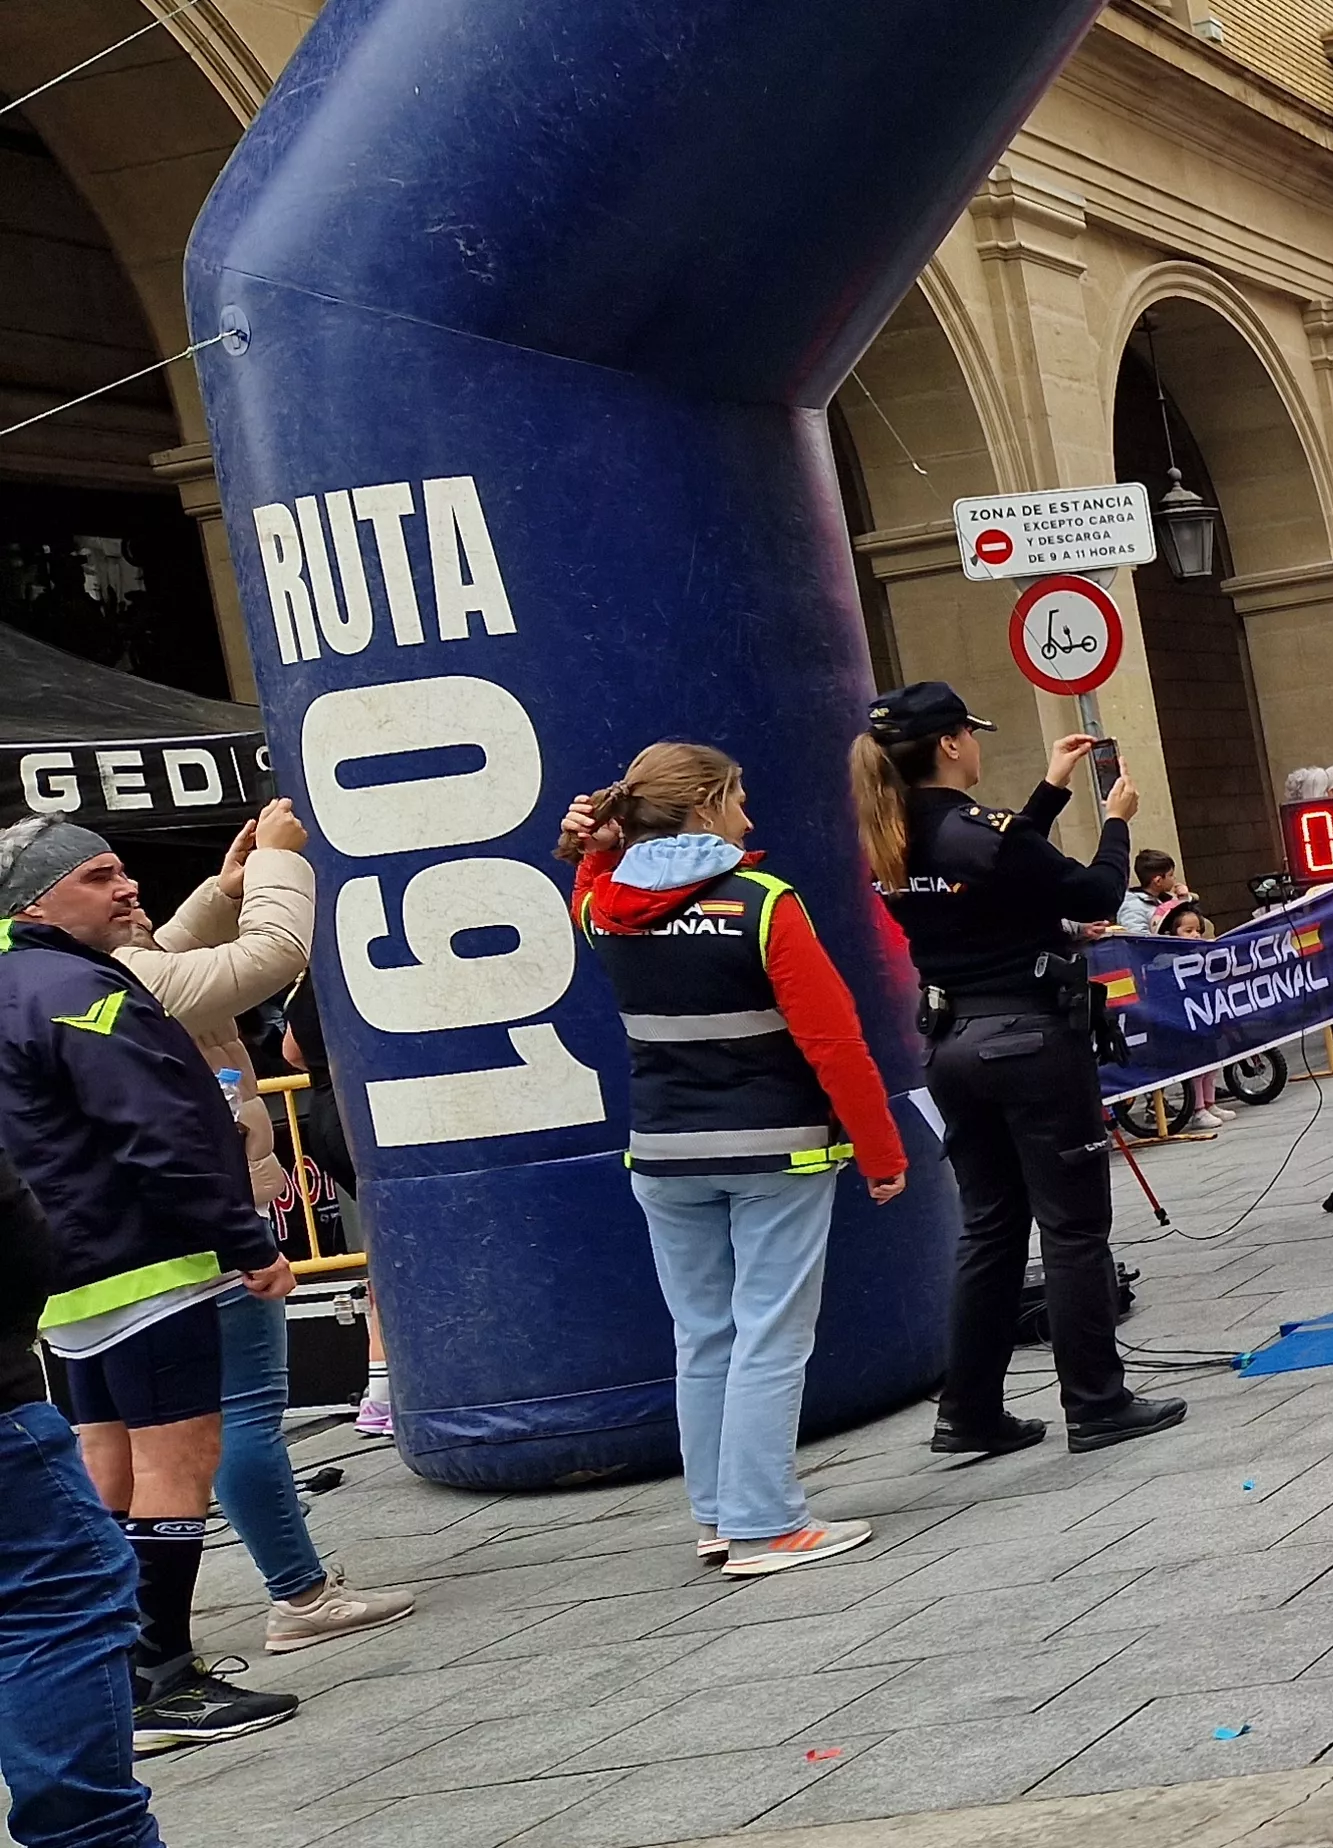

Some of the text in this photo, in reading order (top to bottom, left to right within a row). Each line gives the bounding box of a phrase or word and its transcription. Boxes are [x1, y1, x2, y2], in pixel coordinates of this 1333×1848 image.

[969, 496, 1133, 522] ZONA DE ESTANCIA
[1024, 512, 1136, 532] EXCEPTO CARGA
[1026, 530, 1111, 547] Y DESCARGA
[1028, 544, 1136, 563] DE 9 A 11 HORAS
[252, 475, 517, 665] RUTA
[302, 675, 606, 1147] 091
[1183, 960, 1329, 1031] NACIONAL
